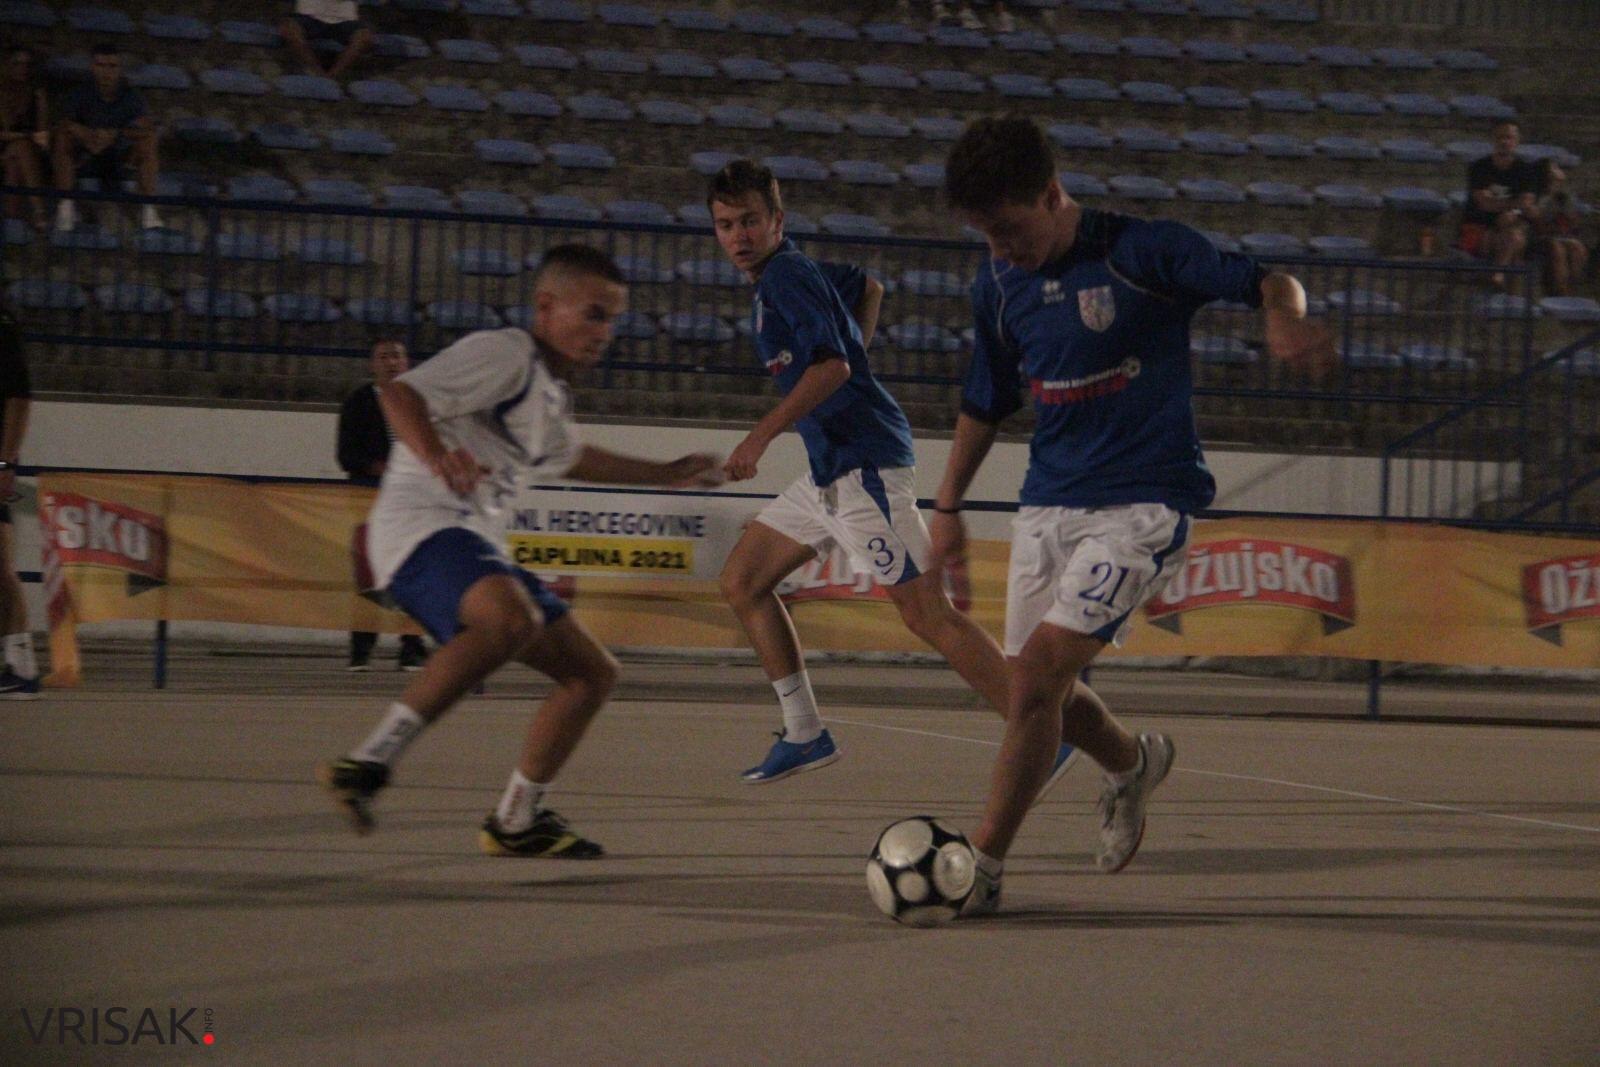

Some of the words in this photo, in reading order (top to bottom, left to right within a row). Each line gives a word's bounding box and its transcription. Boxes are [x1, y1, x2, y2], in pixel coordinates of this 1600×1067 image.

[549, 510, 705, 537] HERCEGOVINE
[630, 550, 686, 569] 2021
[868, 536, 894, 567] 3
[1078, 561, 1129, 607] 21
[1539, 559, 1600, 614] Ož
